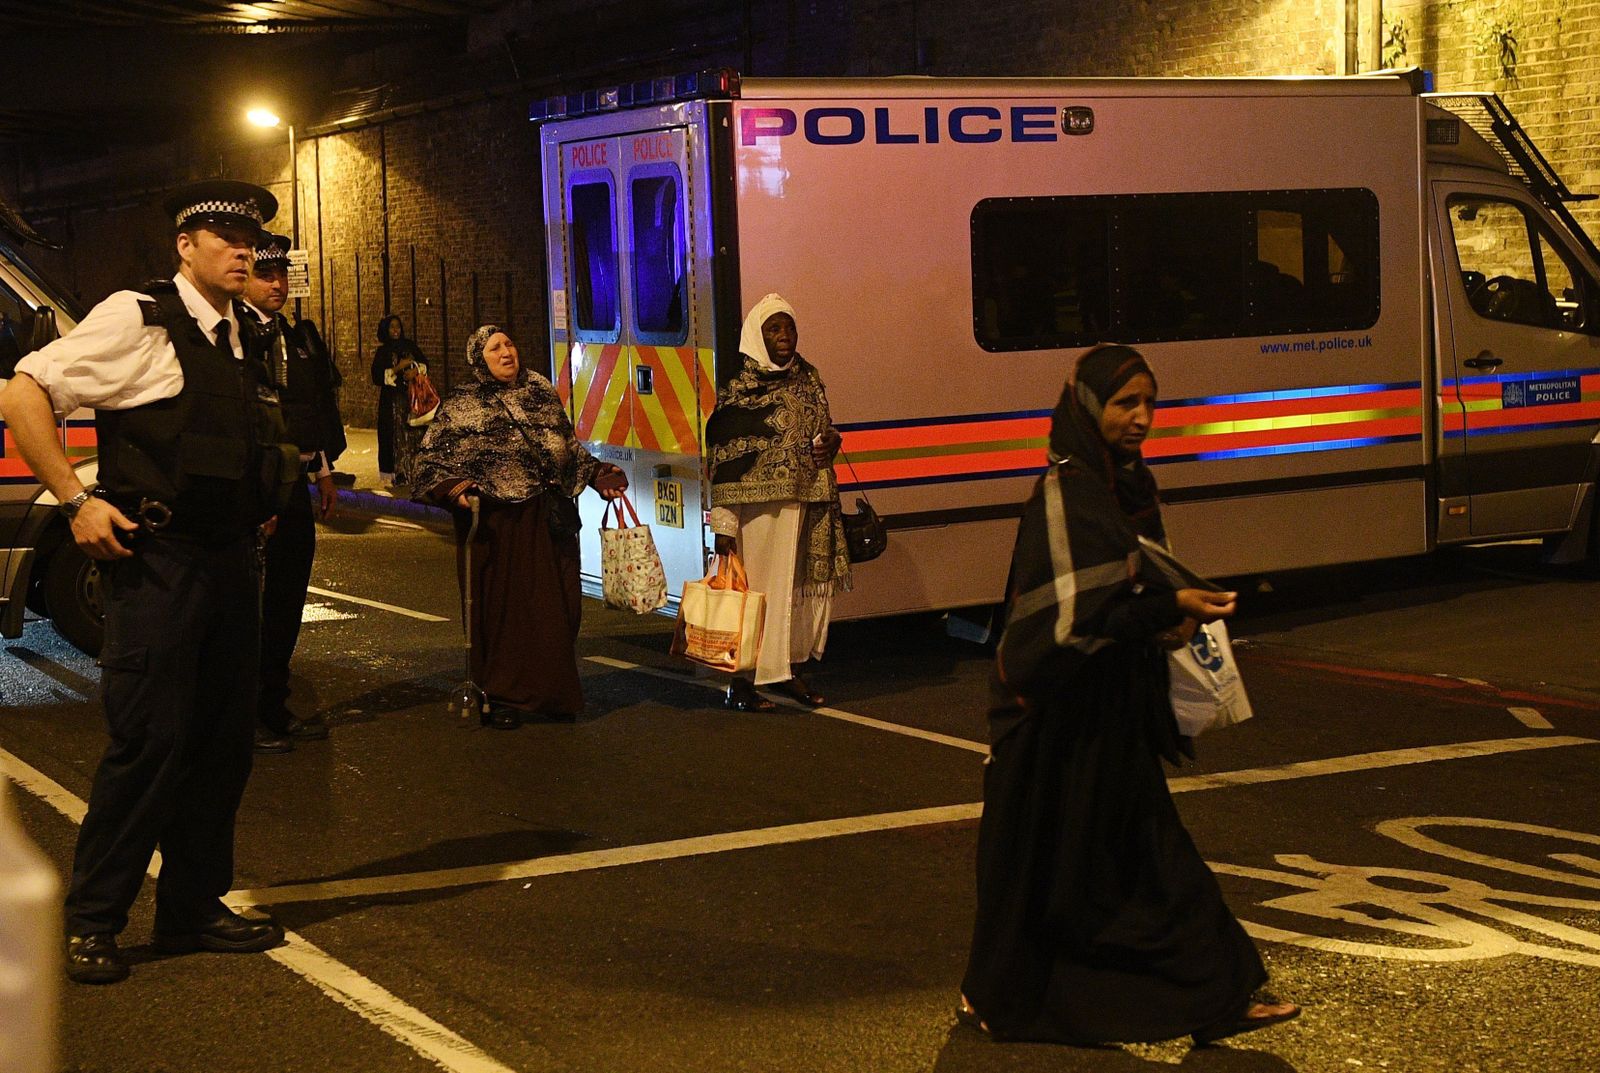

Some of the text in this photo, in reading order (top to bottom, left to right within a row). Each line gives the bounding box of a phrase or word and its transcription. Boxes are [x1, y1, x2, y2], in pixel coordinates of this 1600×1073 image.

[740, 107, 1058, 146] POLICE
[572, 143, 608, 168] POLICE
[633, 135, 673, 161] POLICE
[1260, 335, 1372, 353] www.met.police.uk
[1528, 381, 1577, 391] METROPOLITAN
[1535, 391, 1571, 401] POLICE
[657, 481, 678, 502] BX61
[659, 504, 677, 524] DZN
